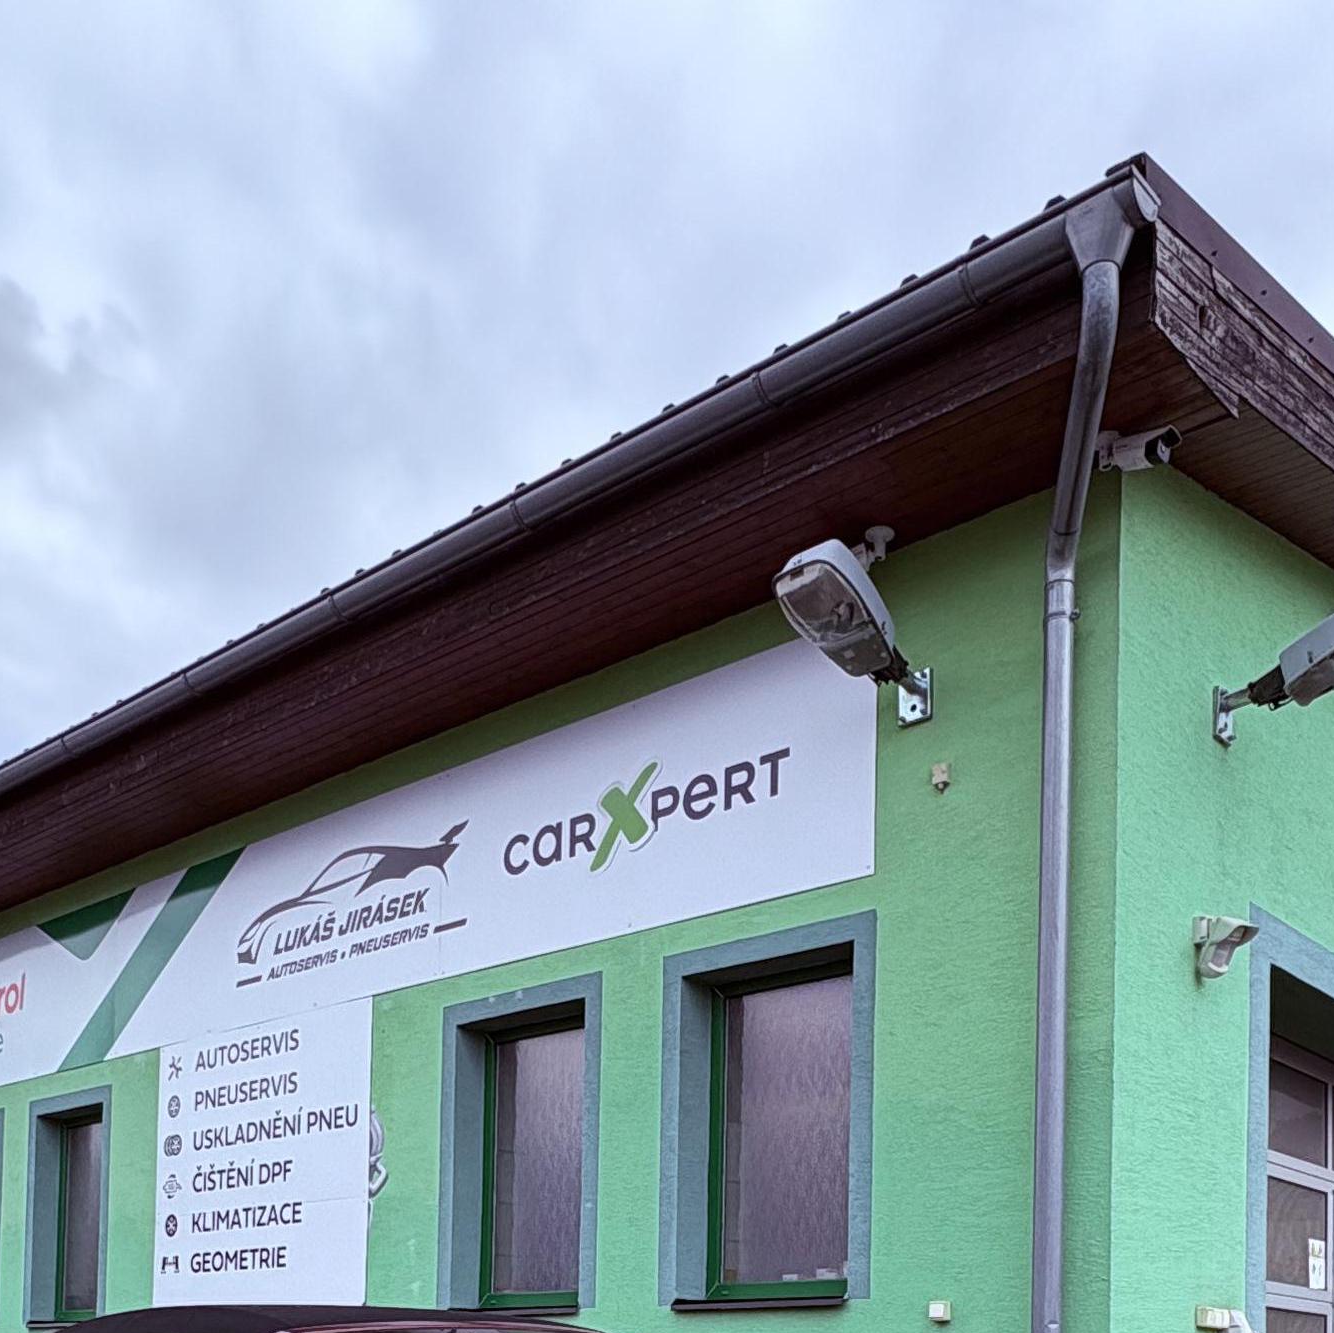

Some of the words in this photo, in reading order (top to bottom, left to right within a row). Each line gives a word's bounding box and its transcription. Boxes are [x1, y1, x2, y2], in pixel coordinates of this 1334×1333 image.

[273, 910, 336, 955] LUKÁŠ
[338, 887, 430, 937] JIRÁSEK
[267, 949, 339, 981] AUTOSERVIS
[349, 923, 430, 959] PNEUSERVIS
[195, 1028, 300, 1072] AUTOSERVIS
[194, 1072, 298, 1111] PNEUSERVIS
[193, 1106, 303, 1151] USKLADNĚNÍ
[306, 1103, 358, 1134] PNEU
[192, 1158, 255, 1193] ČIŠTĚNÍ
[258, 1159, 293, 1185] DPF
[191, 1202, 303, 1234] KLIMATIZACE
[190, 1246, 287, 1274] GEOMETRIE
